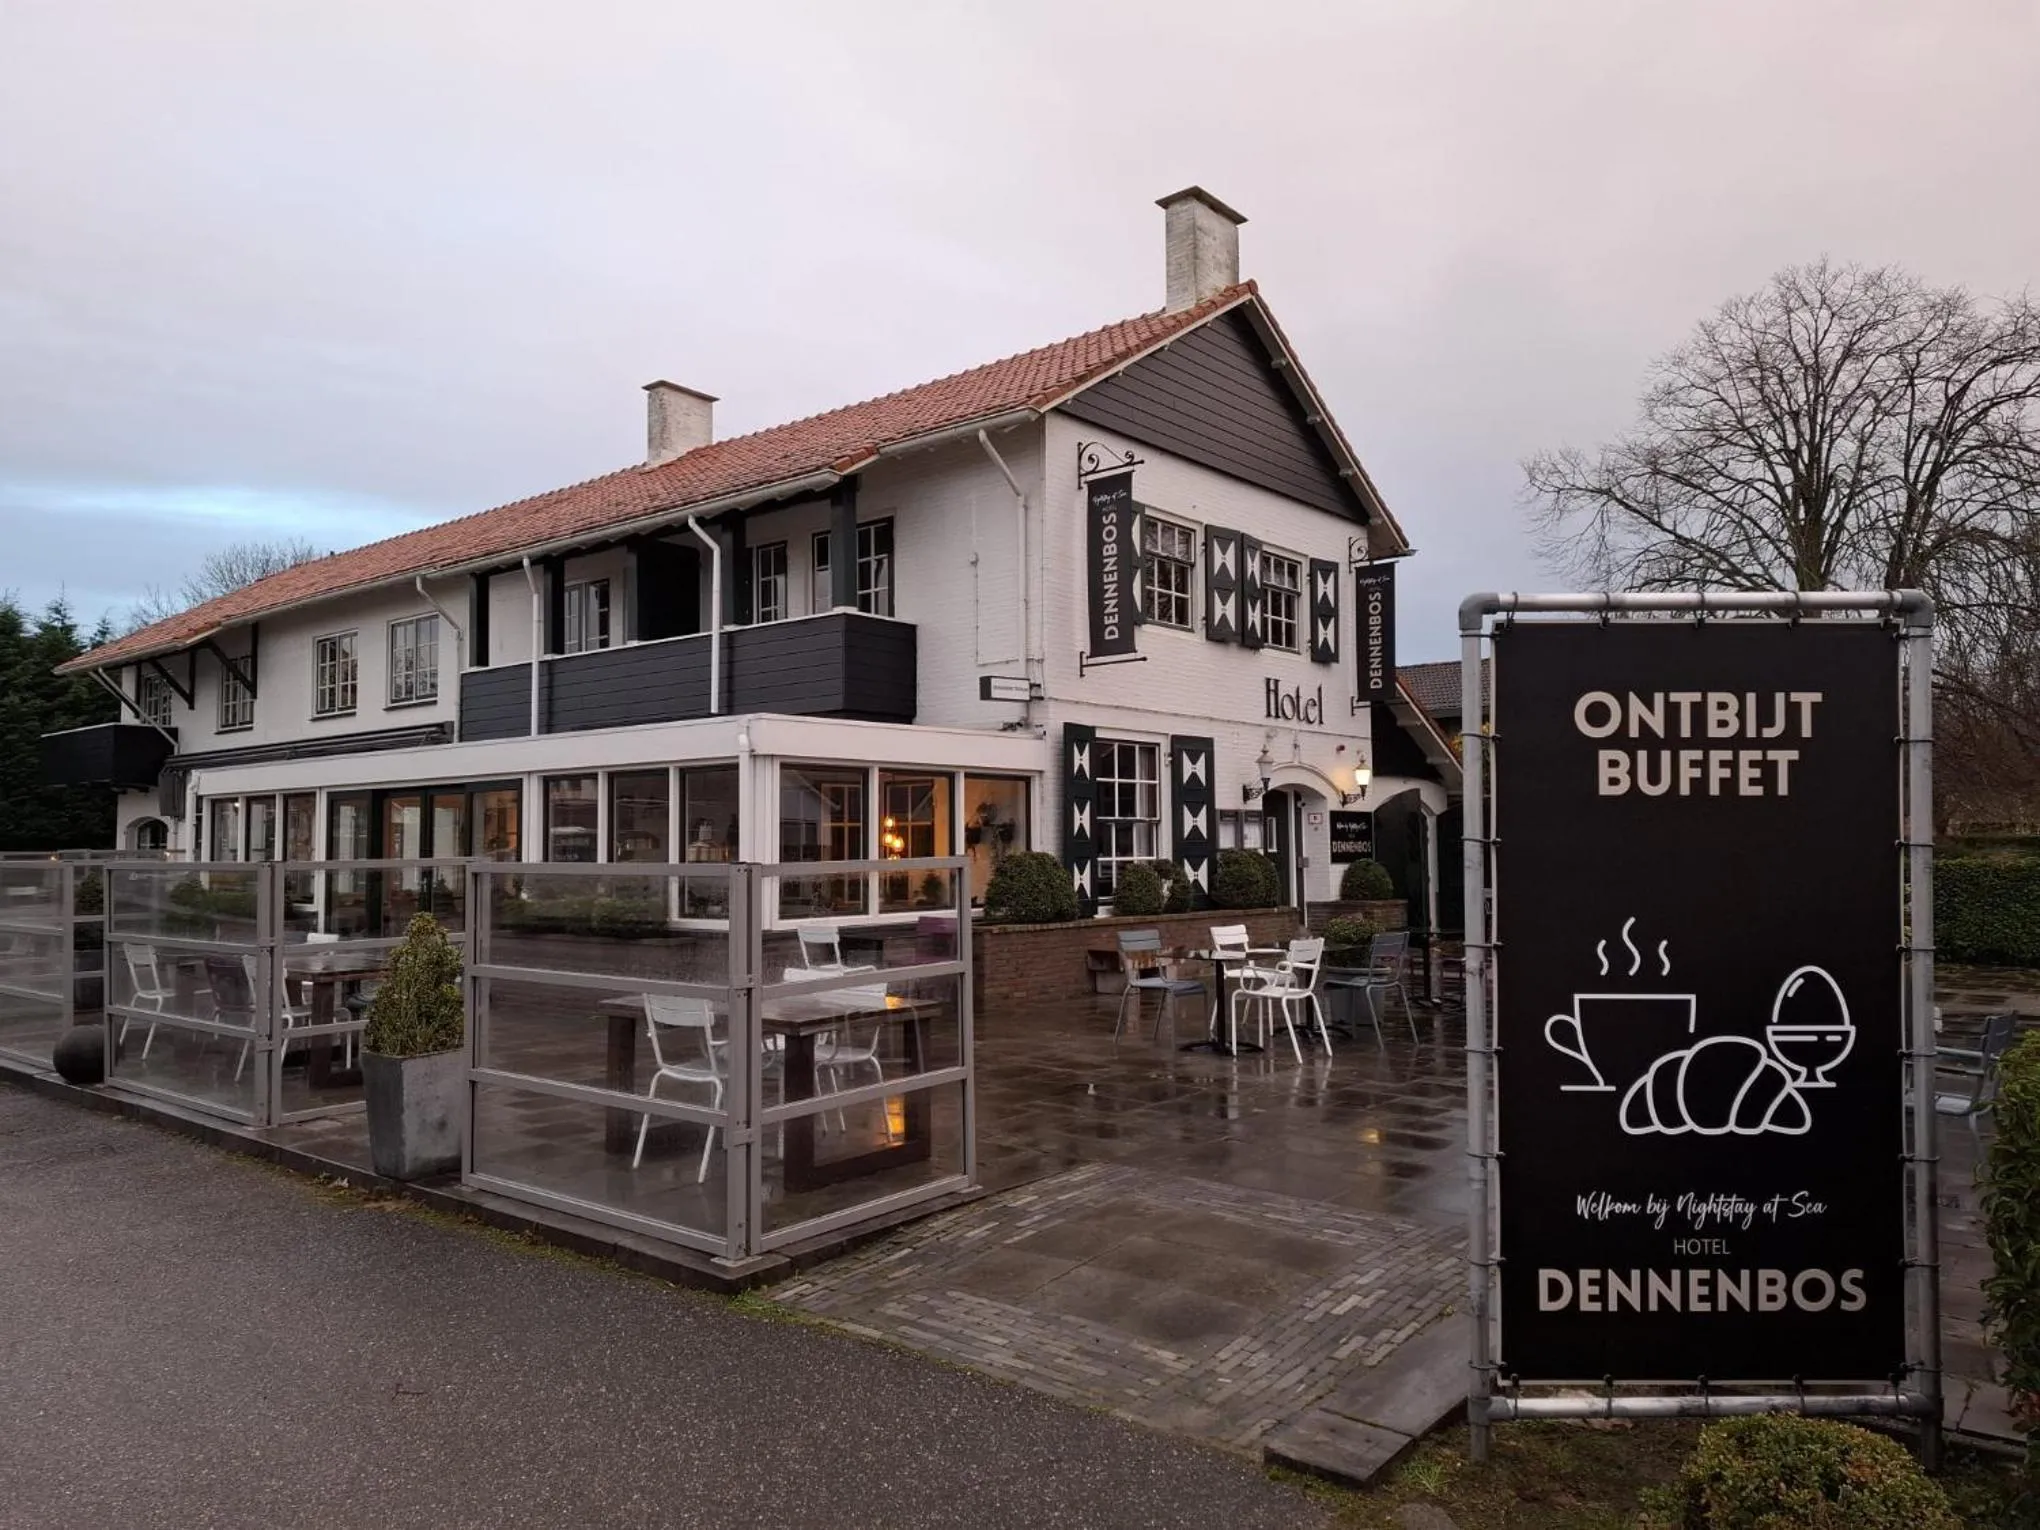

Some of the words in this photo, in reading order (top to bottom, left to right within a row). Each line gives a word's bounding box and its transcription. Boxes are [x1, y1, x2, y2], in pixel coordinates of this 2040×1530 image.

[1102, 512, 1119, 640] DENNENBOS
[1368, 592, 1383, 689] DENNENBOS
[1265, 677, 1324, 725] Hotel
[1573, 691, 1823, 739] ONTBIJT
[1598, 749, 1799, 796] BUFFET
[1576, 1191, 1641, 1221] Welkom
[1645, 1193, 1669, 1230] bij
[1677, 1193, 1758, 1230] Nightstay
[1762, 1193, 1788, 1223] at
[1787, 1190, 1827, 1218] Sea
[1673, 1238, 1731, 1255] HOTEL
[1537, 1268, 1867, 1313] DENNENBOS
